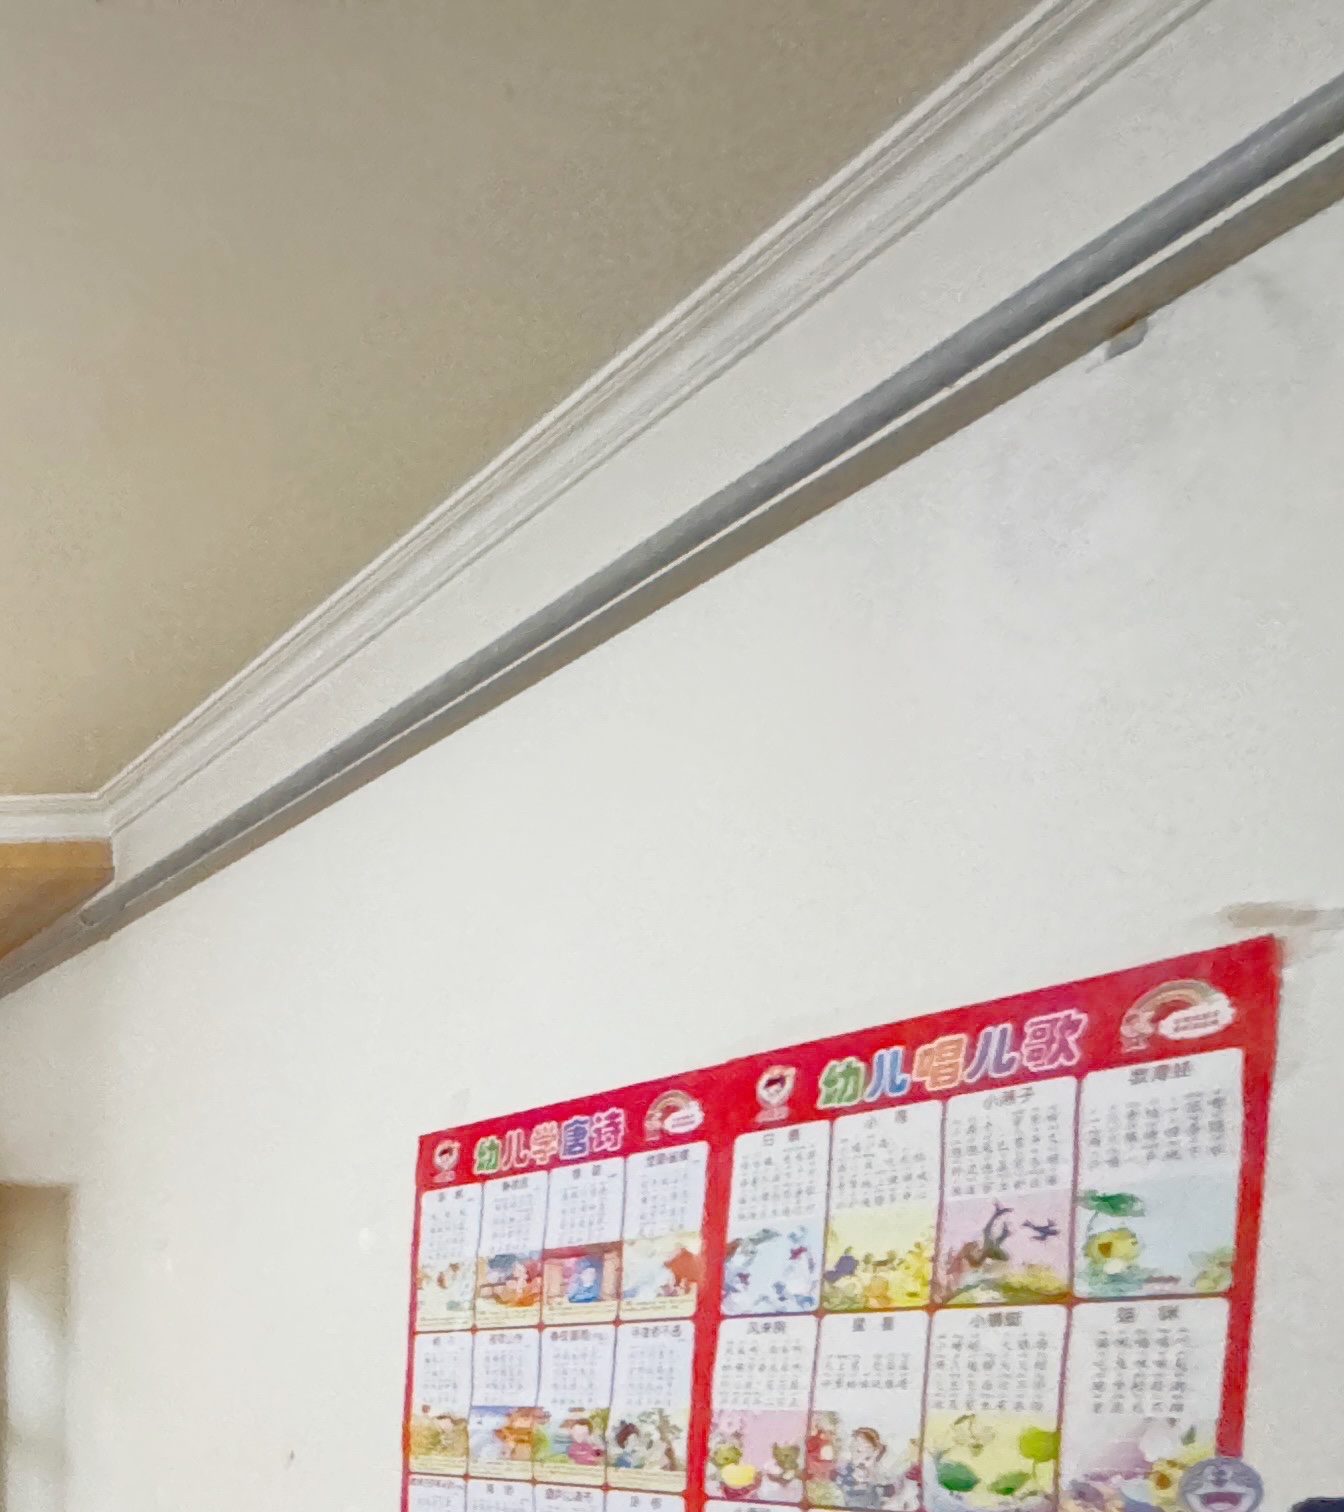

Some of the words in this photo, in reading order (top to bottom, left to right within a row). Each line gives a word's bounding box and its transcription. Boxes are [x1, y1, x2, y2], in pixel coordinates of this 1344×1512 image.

[816, 1008, 1089, 1110] 幼儿唱儿歌
[472, 1107, 625, 1175] 幼儿学唐诗
